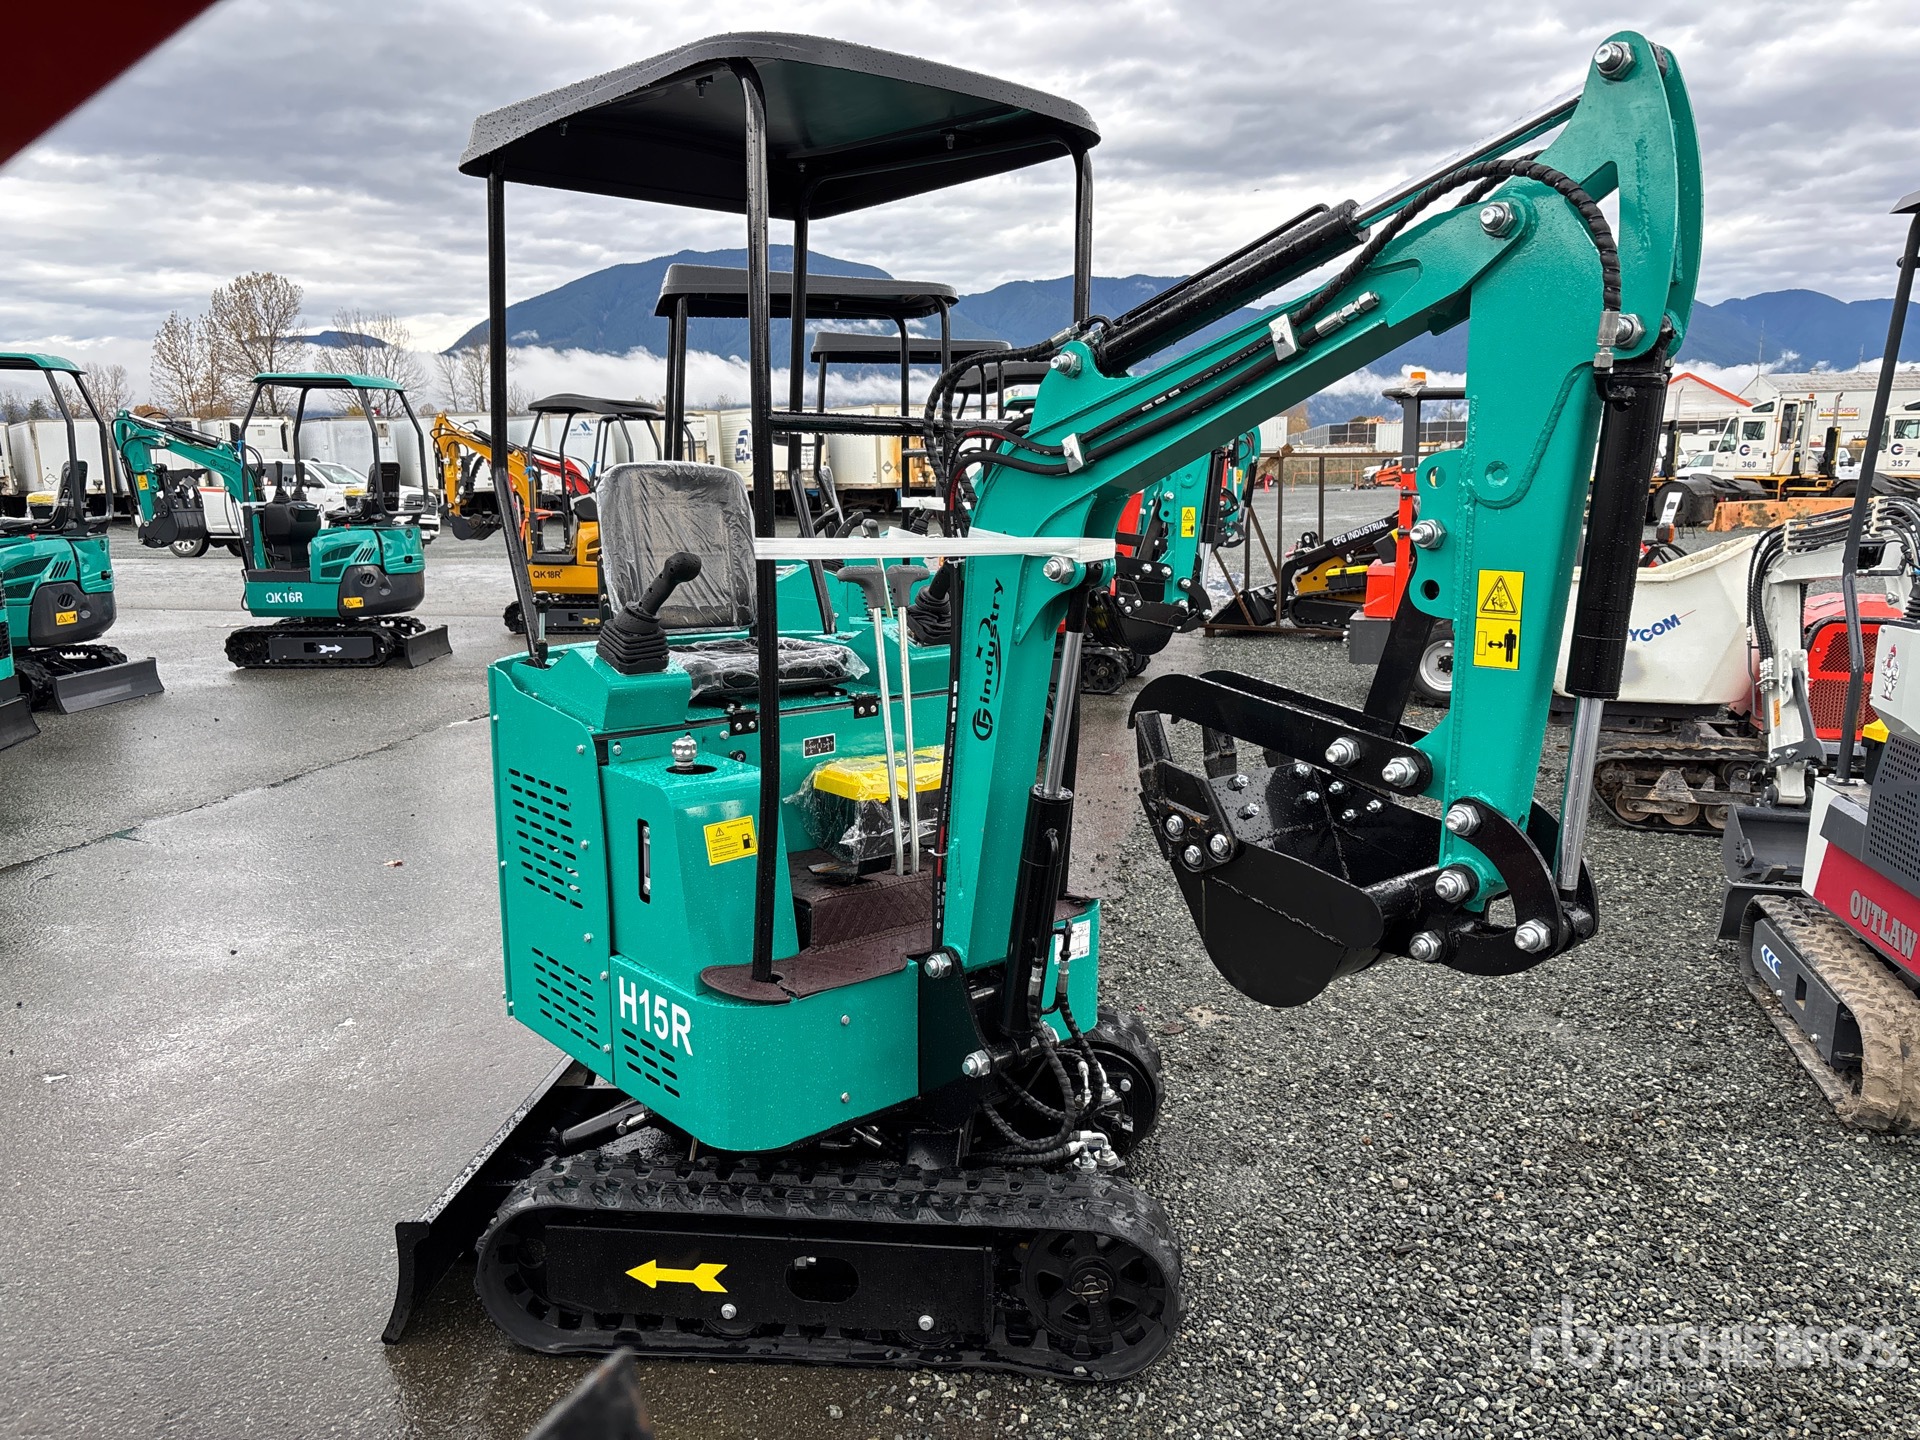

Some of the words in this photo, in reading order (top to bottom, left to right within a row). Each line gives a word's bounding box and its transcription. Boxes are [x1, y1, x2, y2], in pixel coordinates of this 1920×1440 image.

[1332, 535, 1347, 546] CFG
[1347, 519, 1388, 541] INDUSTRIAL
[266, 592, 303, 603] QK16R
[1850, 889, 1918, 961] OUTLAW
[619, 975, 693, 1057] H15R
